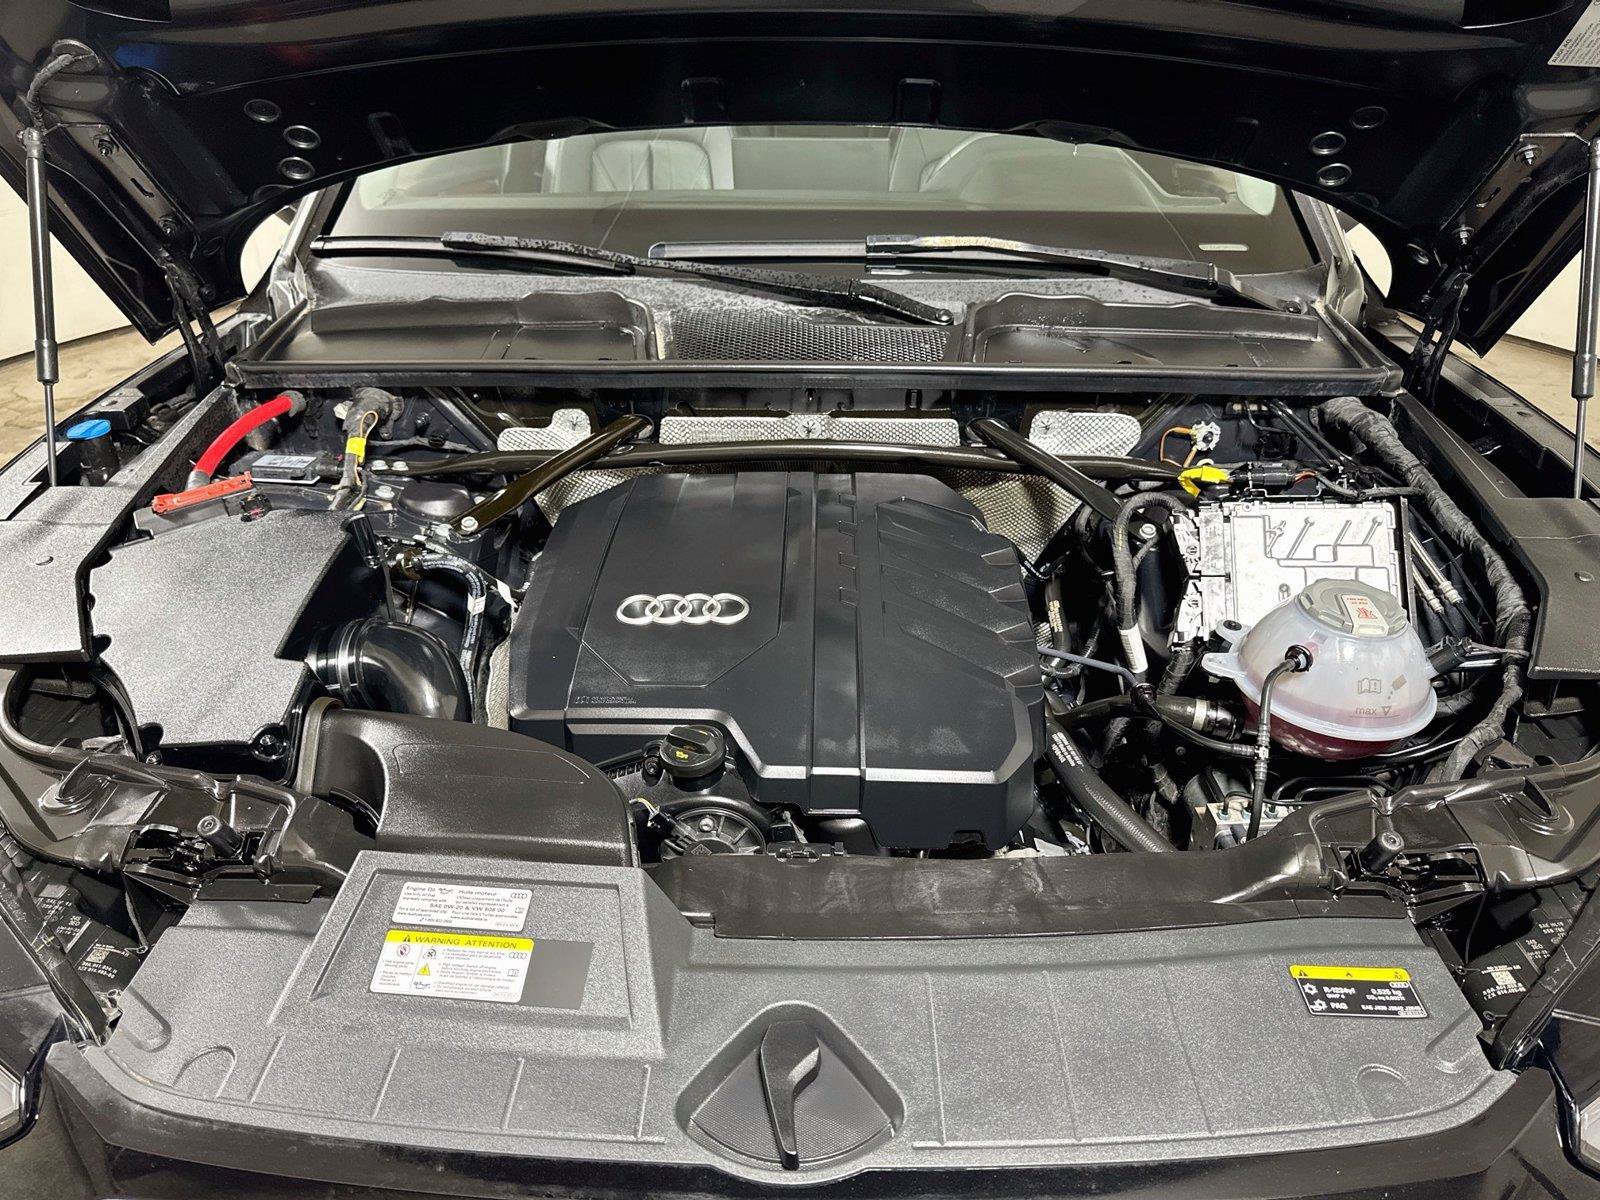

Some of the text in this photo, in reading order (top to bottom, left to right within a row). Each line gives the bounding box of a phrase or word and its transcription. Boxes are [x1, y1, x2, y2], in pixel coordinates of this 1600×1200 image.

[1355, 706, 1377, 715] max
[406, 885, 426, 893] Engine
[415, 936, 517, 949] WARNING ATTENTION
[1392, 989, 1402, 997] kg
[1329, 1002, 1349, 1010] PAG
